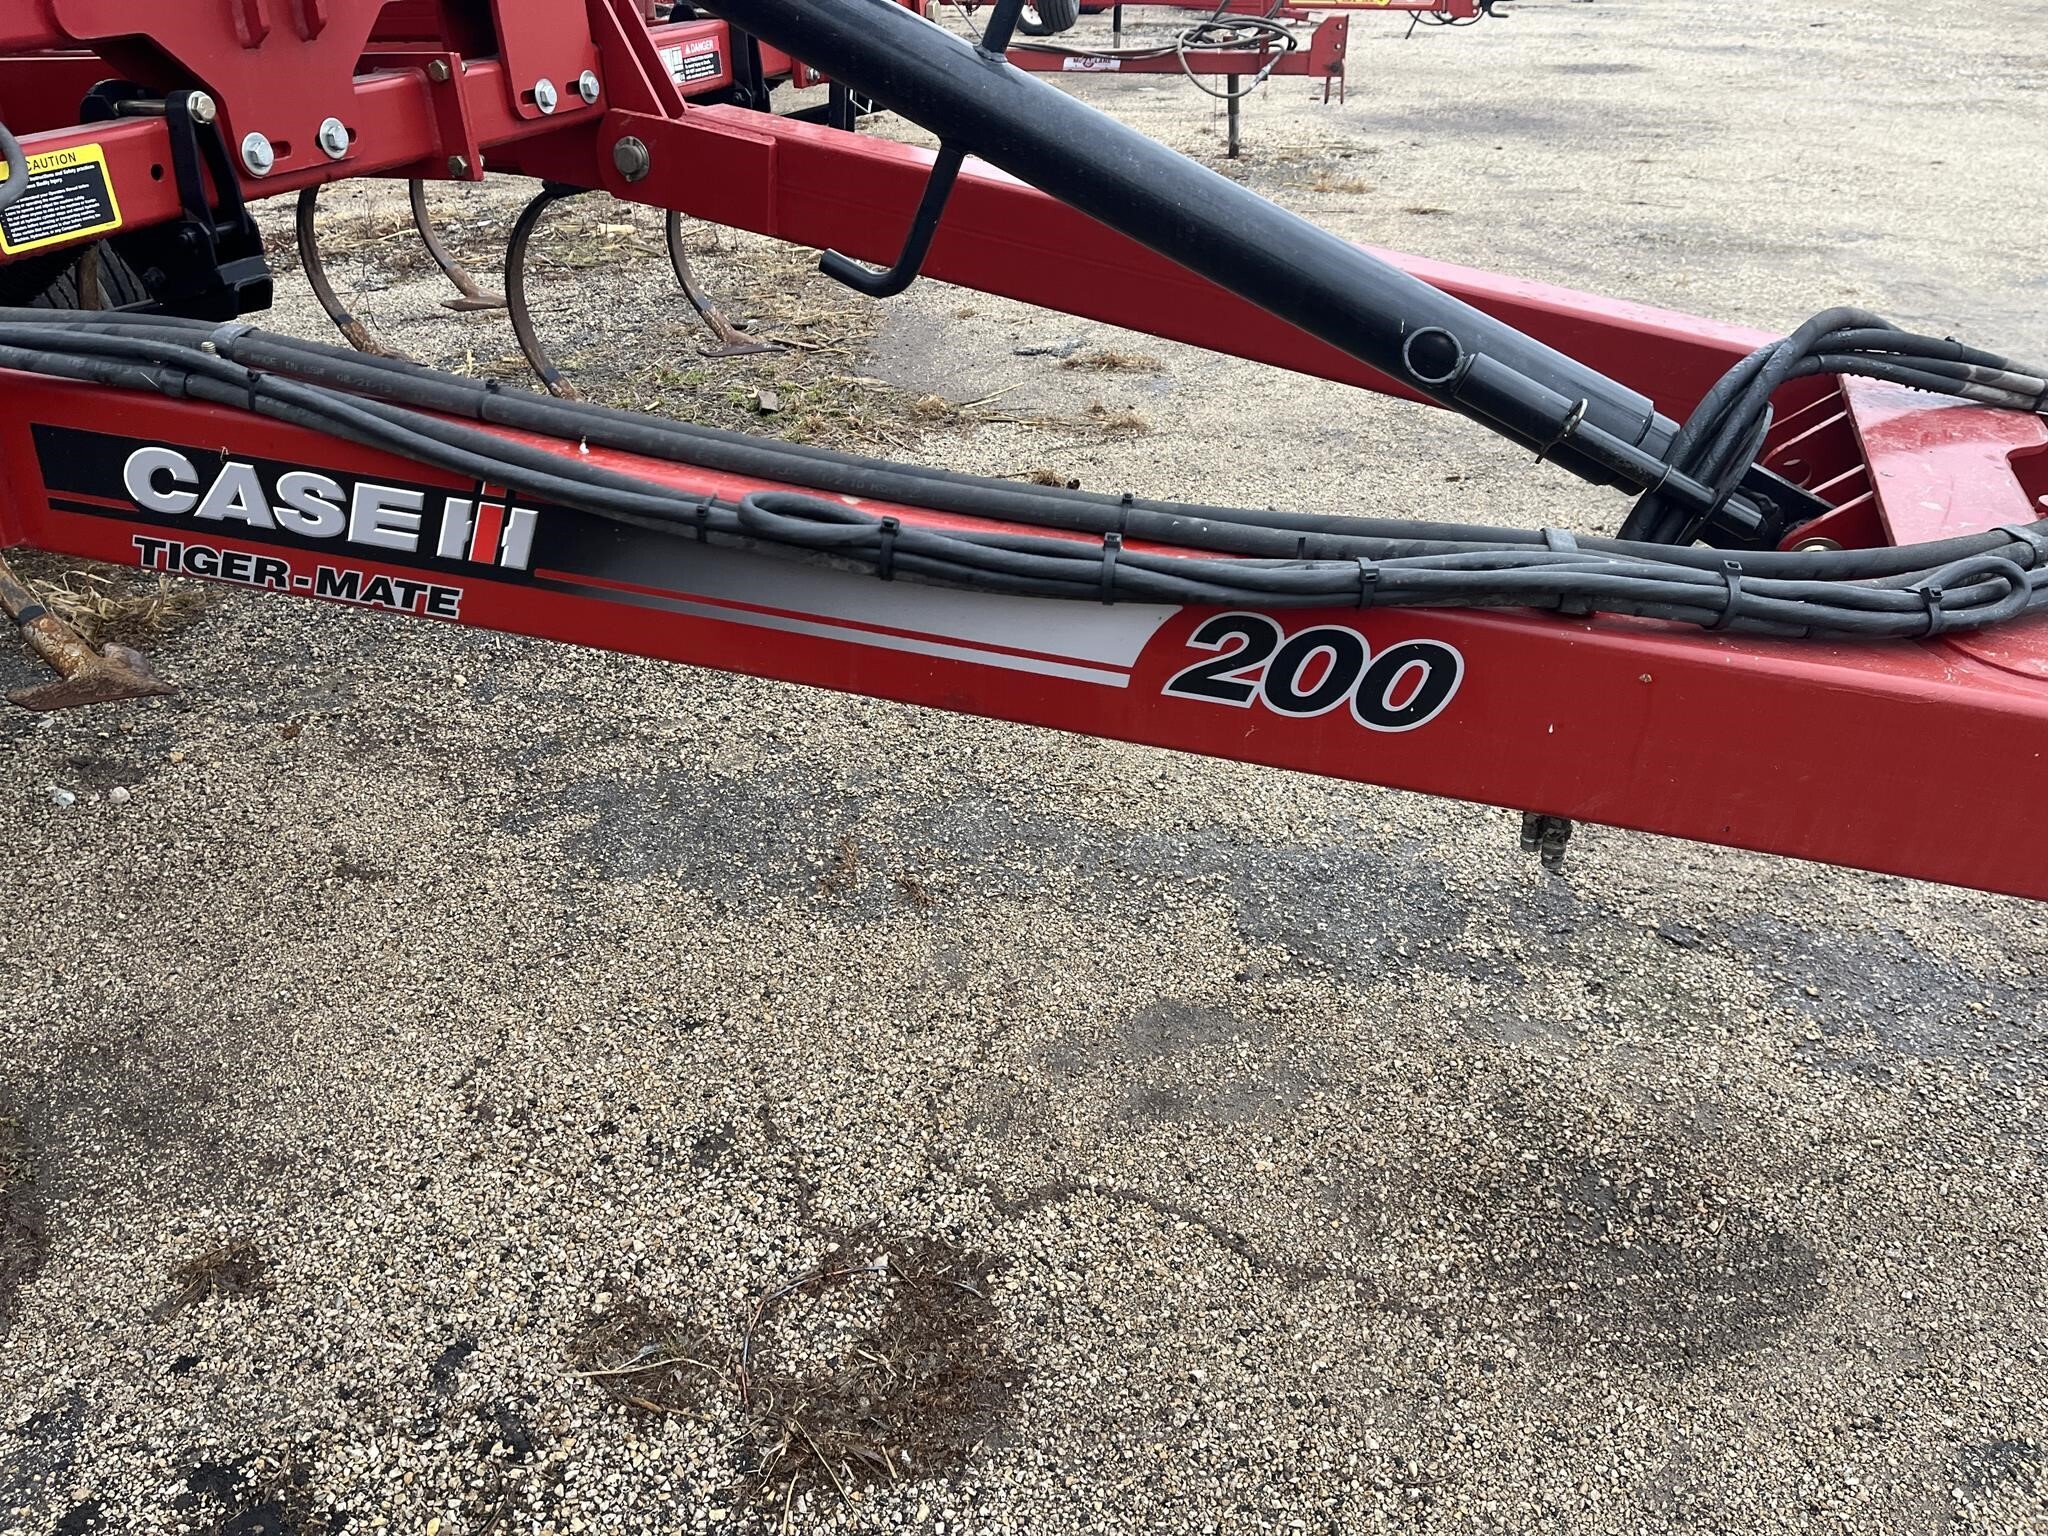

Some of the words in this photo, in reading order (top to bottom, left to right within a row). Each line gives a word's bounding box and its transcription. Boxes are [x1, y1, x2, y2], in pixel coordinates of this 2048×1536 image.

[123, 446, 425, 552] CASE
[132, 535, 463, 620] TIGER-MATE
[1161, 611, 1465, 732] 200
